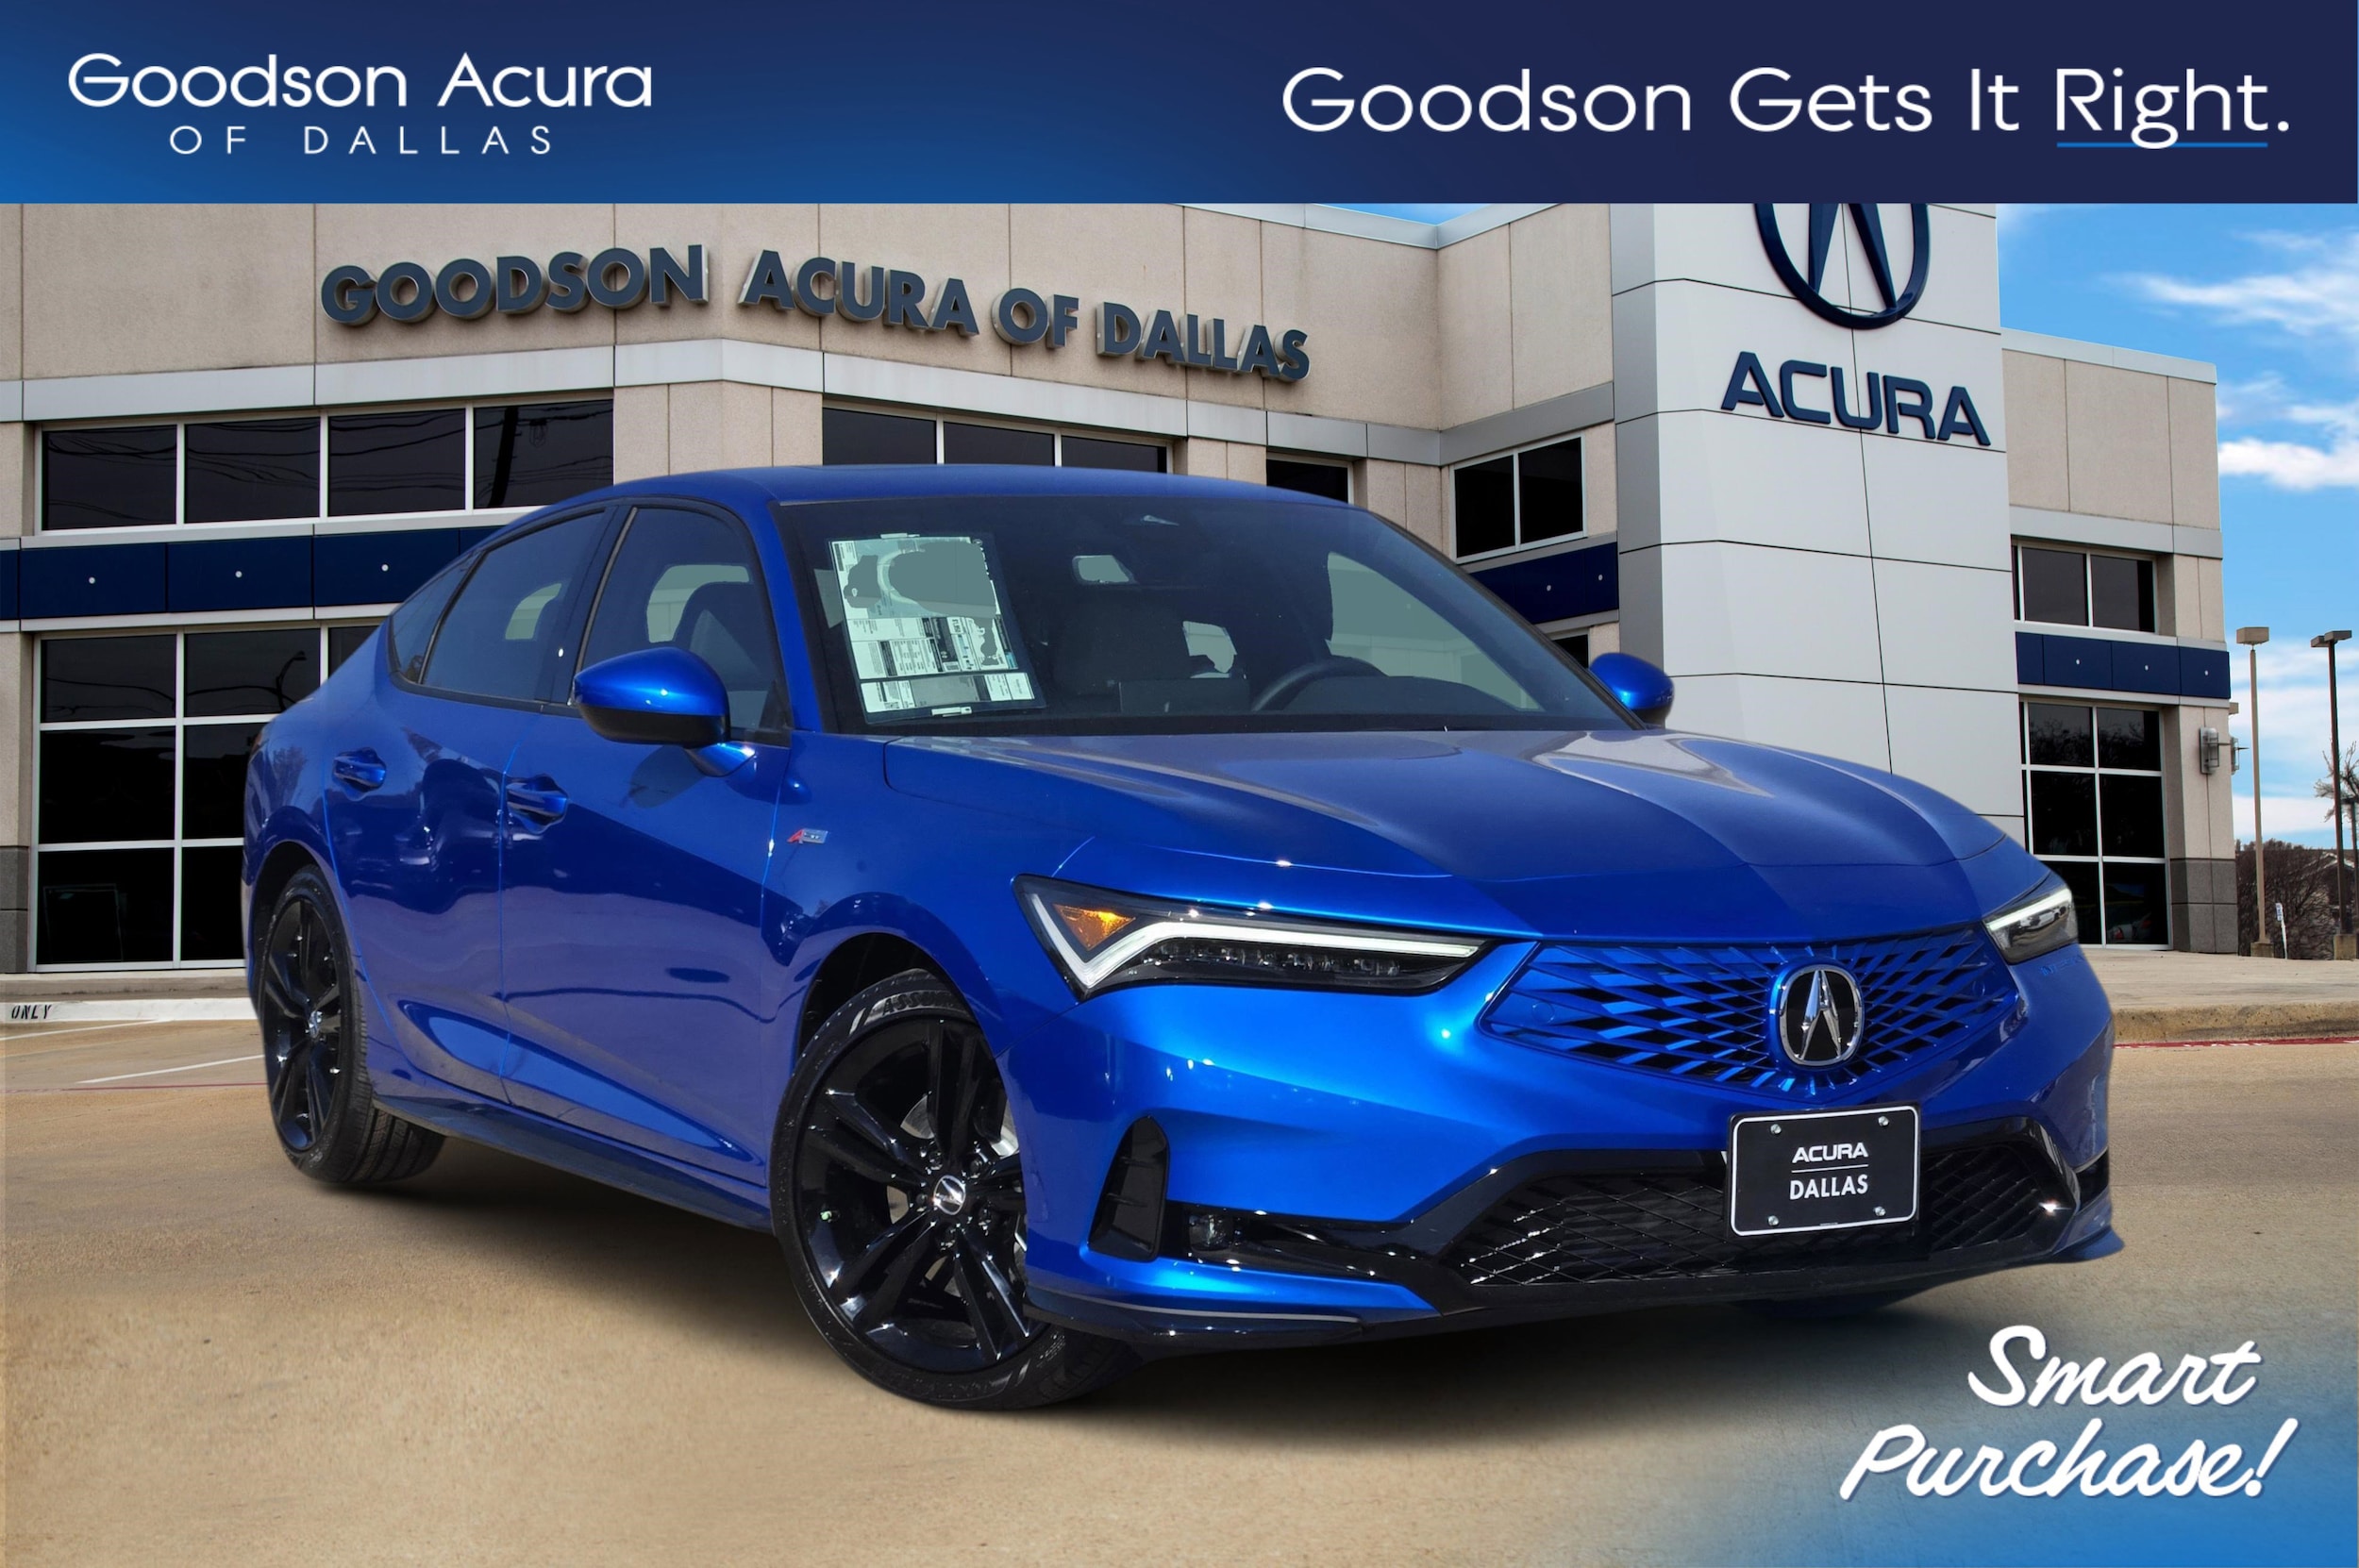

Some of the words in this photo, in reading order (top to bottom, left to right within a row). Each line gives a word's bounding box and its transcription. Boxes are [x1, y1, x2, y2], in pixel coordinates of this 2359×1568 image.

[321, 244, 708, 325] GOODSON
[738, 249, 979, 336] ACURA
[992, 288, 1079, 349] OF
[1096, 302, 1310, 381] DALLAS
[1720, 351, 1991, 446] ACURA
[11, 1004, 52, 1019] ONLY
[1792, 1142, 1869, 1164] ACURA
[1789, 1174, 1869, 1200] DALLAS
